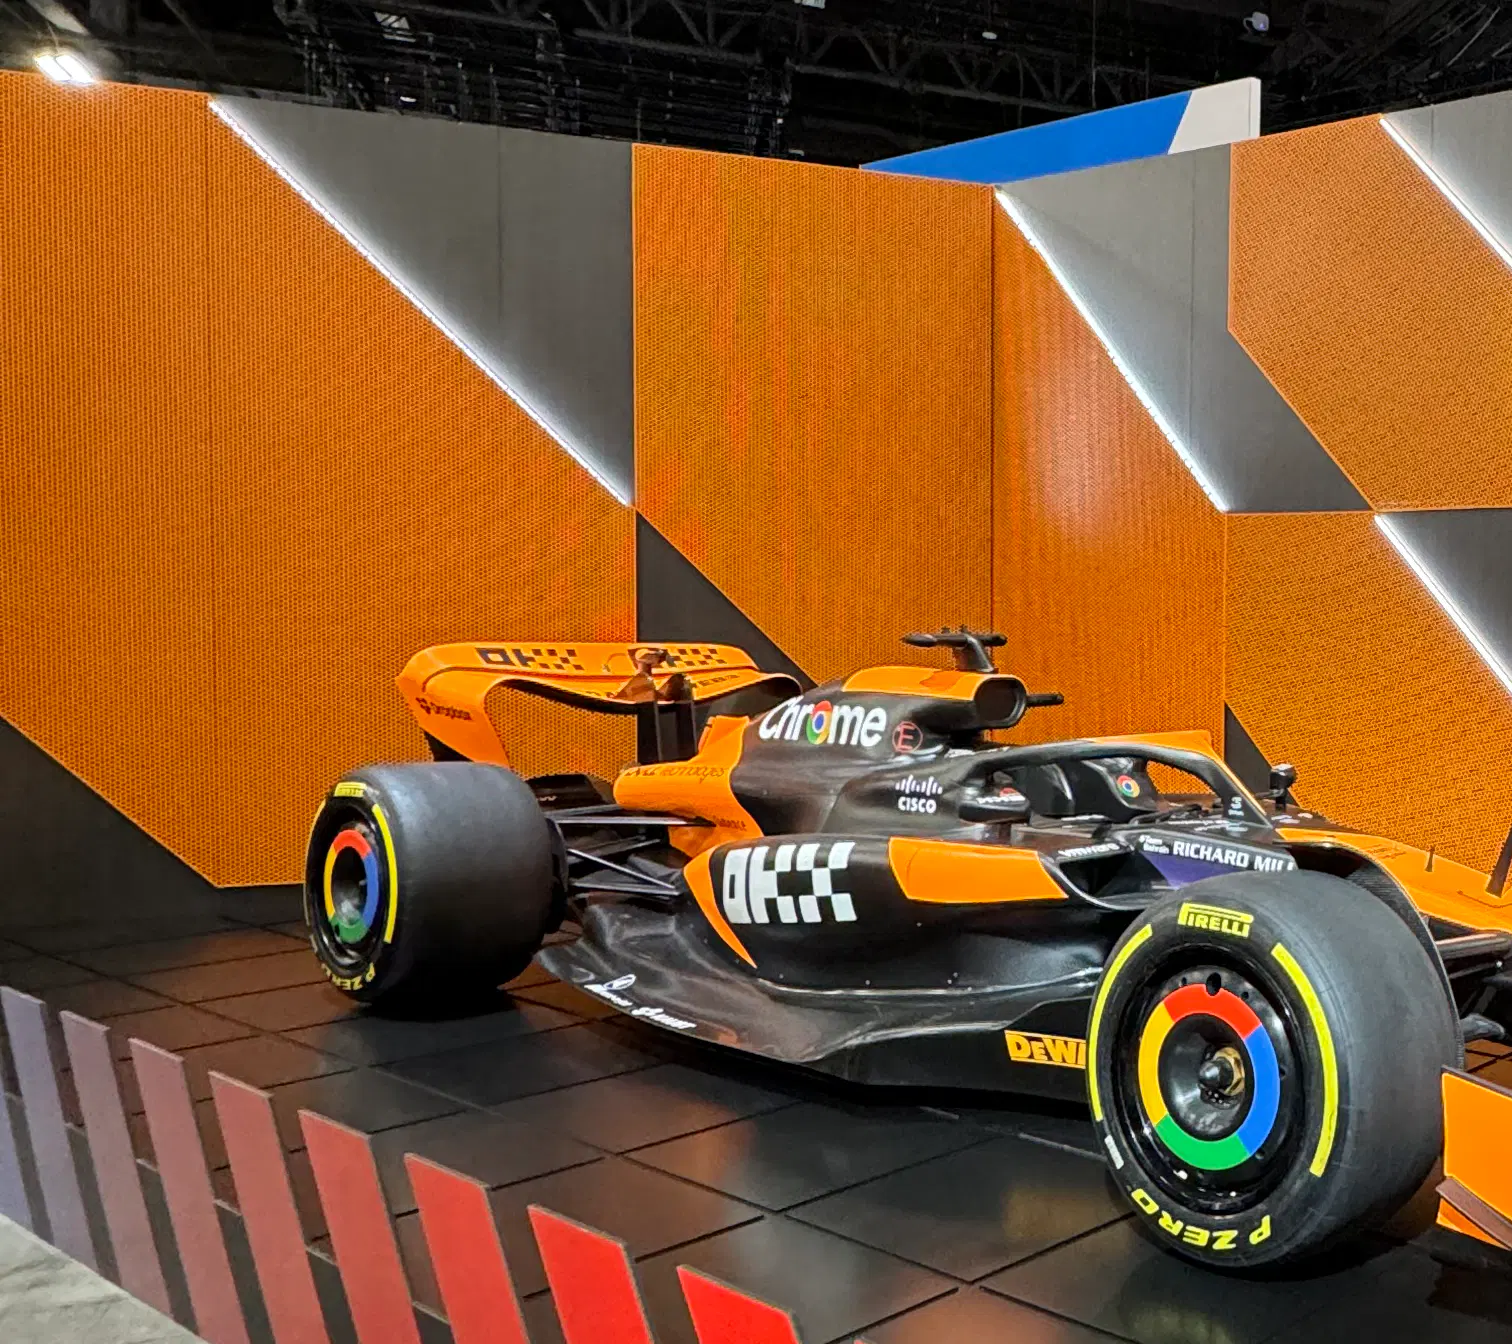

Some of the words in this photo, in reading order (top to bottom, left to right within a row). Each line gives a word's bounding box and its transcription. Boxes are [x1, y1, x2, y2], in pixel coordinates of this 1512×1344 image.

[1173, 841, 1249, 869] RICHARD
[1178, 903, 1254, 938] PIRELLI
[1131, 1188, 1238, 1250] ZERO
[1249, 1214, 1271, 1245] P
